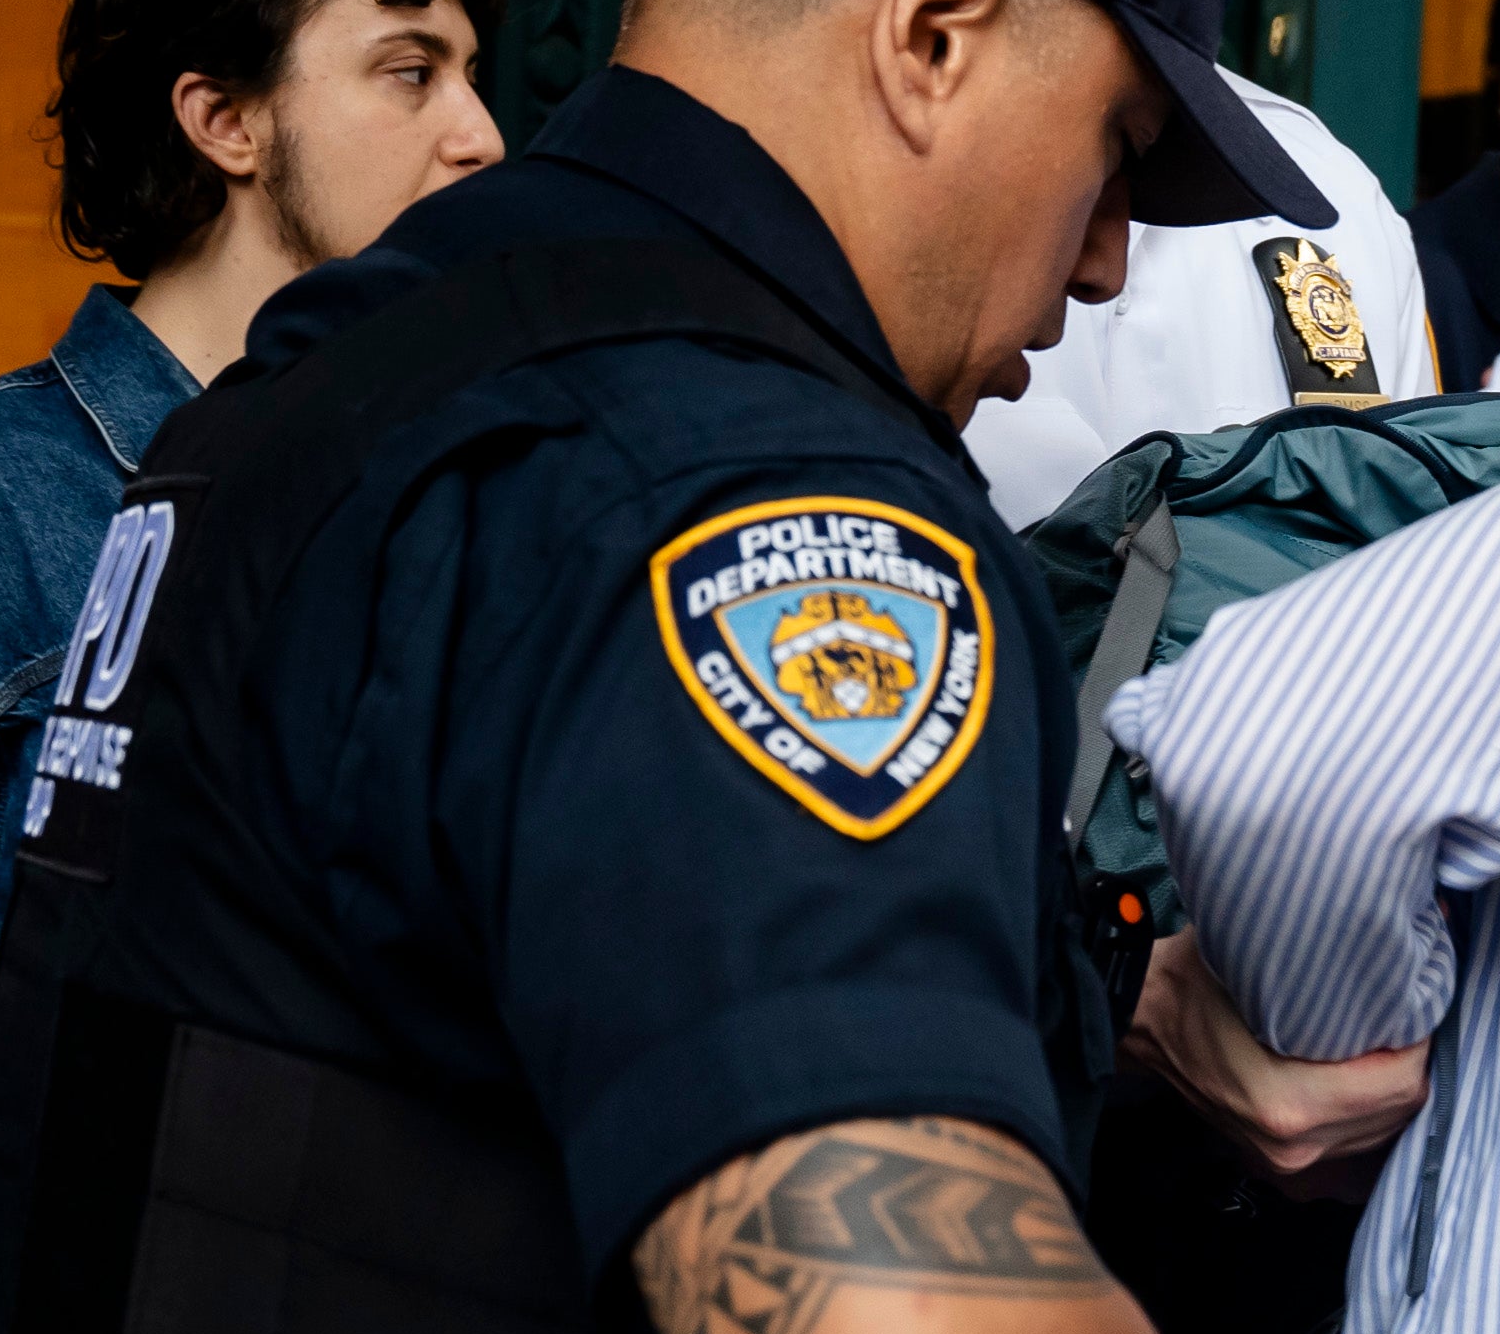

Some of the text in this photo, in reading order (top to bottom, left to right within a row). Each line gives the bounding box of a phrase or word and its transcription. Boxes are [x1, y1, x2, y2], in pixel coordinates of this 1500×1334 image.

[686, 548, 961, 618] DEPARTMENT
[738, 514, 902, 560] POLICE
[698, 649, 829, 776] CITY OF
[886, 628, 980, 788] NEW YORK
